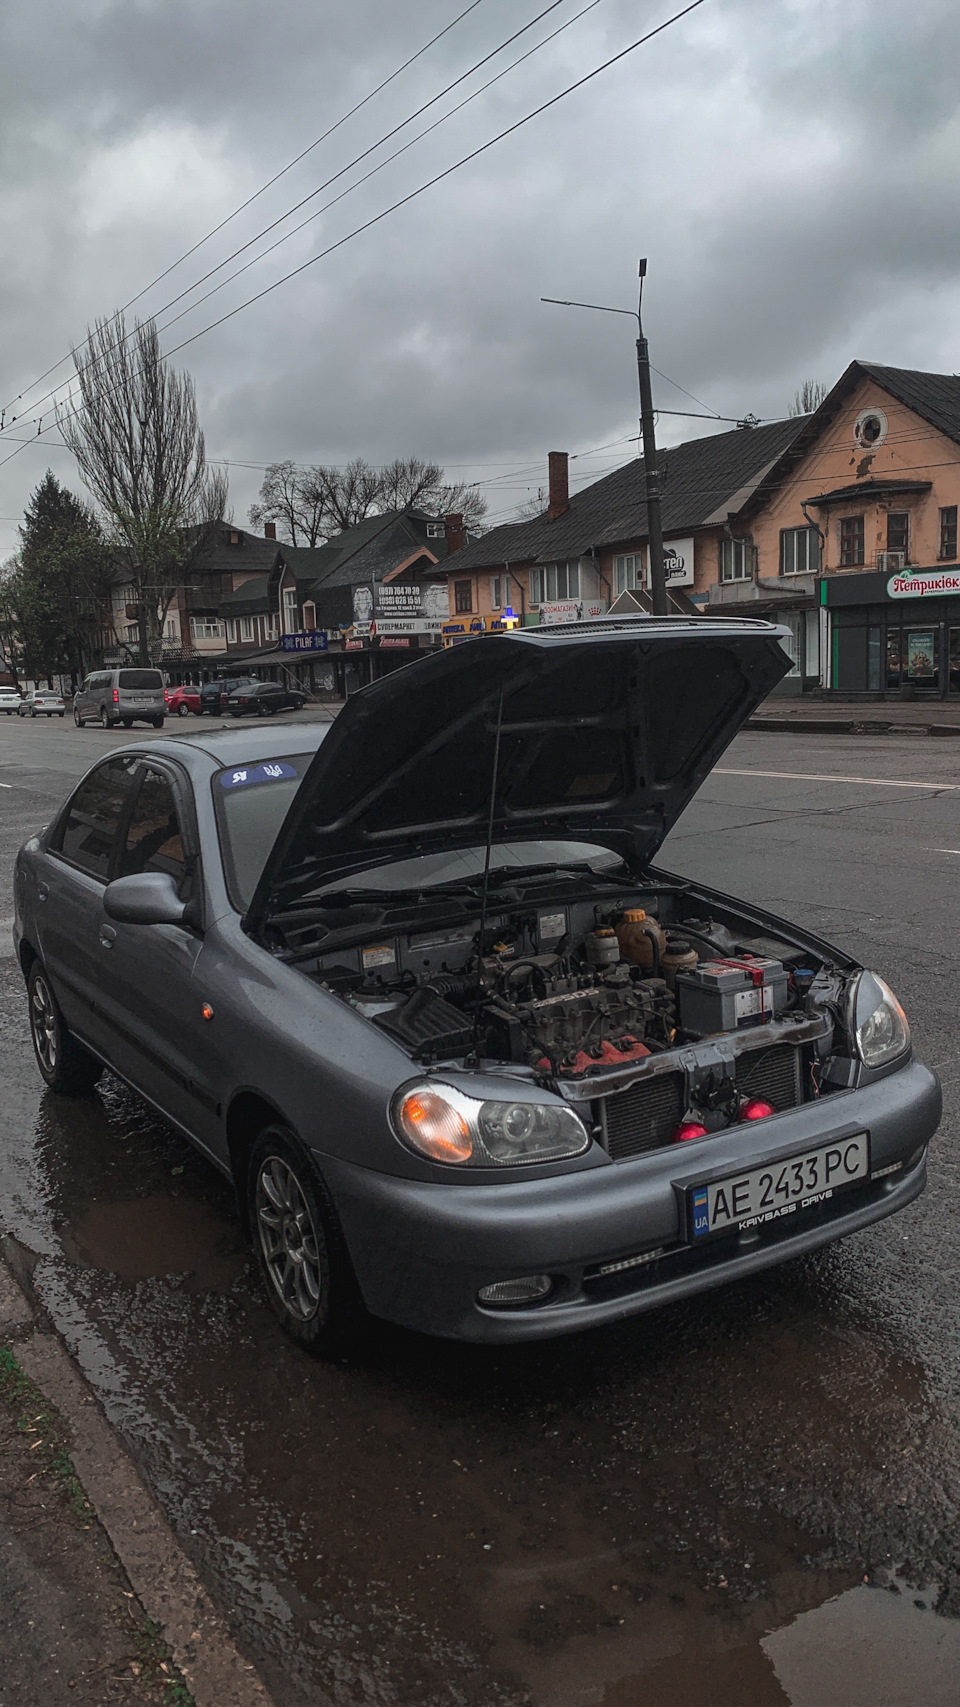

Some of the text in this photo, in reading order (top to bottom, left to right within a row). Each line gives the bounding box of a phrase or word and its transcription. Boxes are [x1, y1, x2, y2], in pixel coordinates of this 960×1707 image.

[893, 575, 960, 595] Петриківк
[377, 622, 415, 631] СУПЕРМАРКЕТ
[443, 624, 465, 634] АПТЕКА
[295, 636, 313, 648] PILAF
[711, 1143, 860, 1225] AE 2433 PC
[738, 1189, 834, 1231] KRIVBASS DRIVE
[694, 1215, 708, 1229] UA
